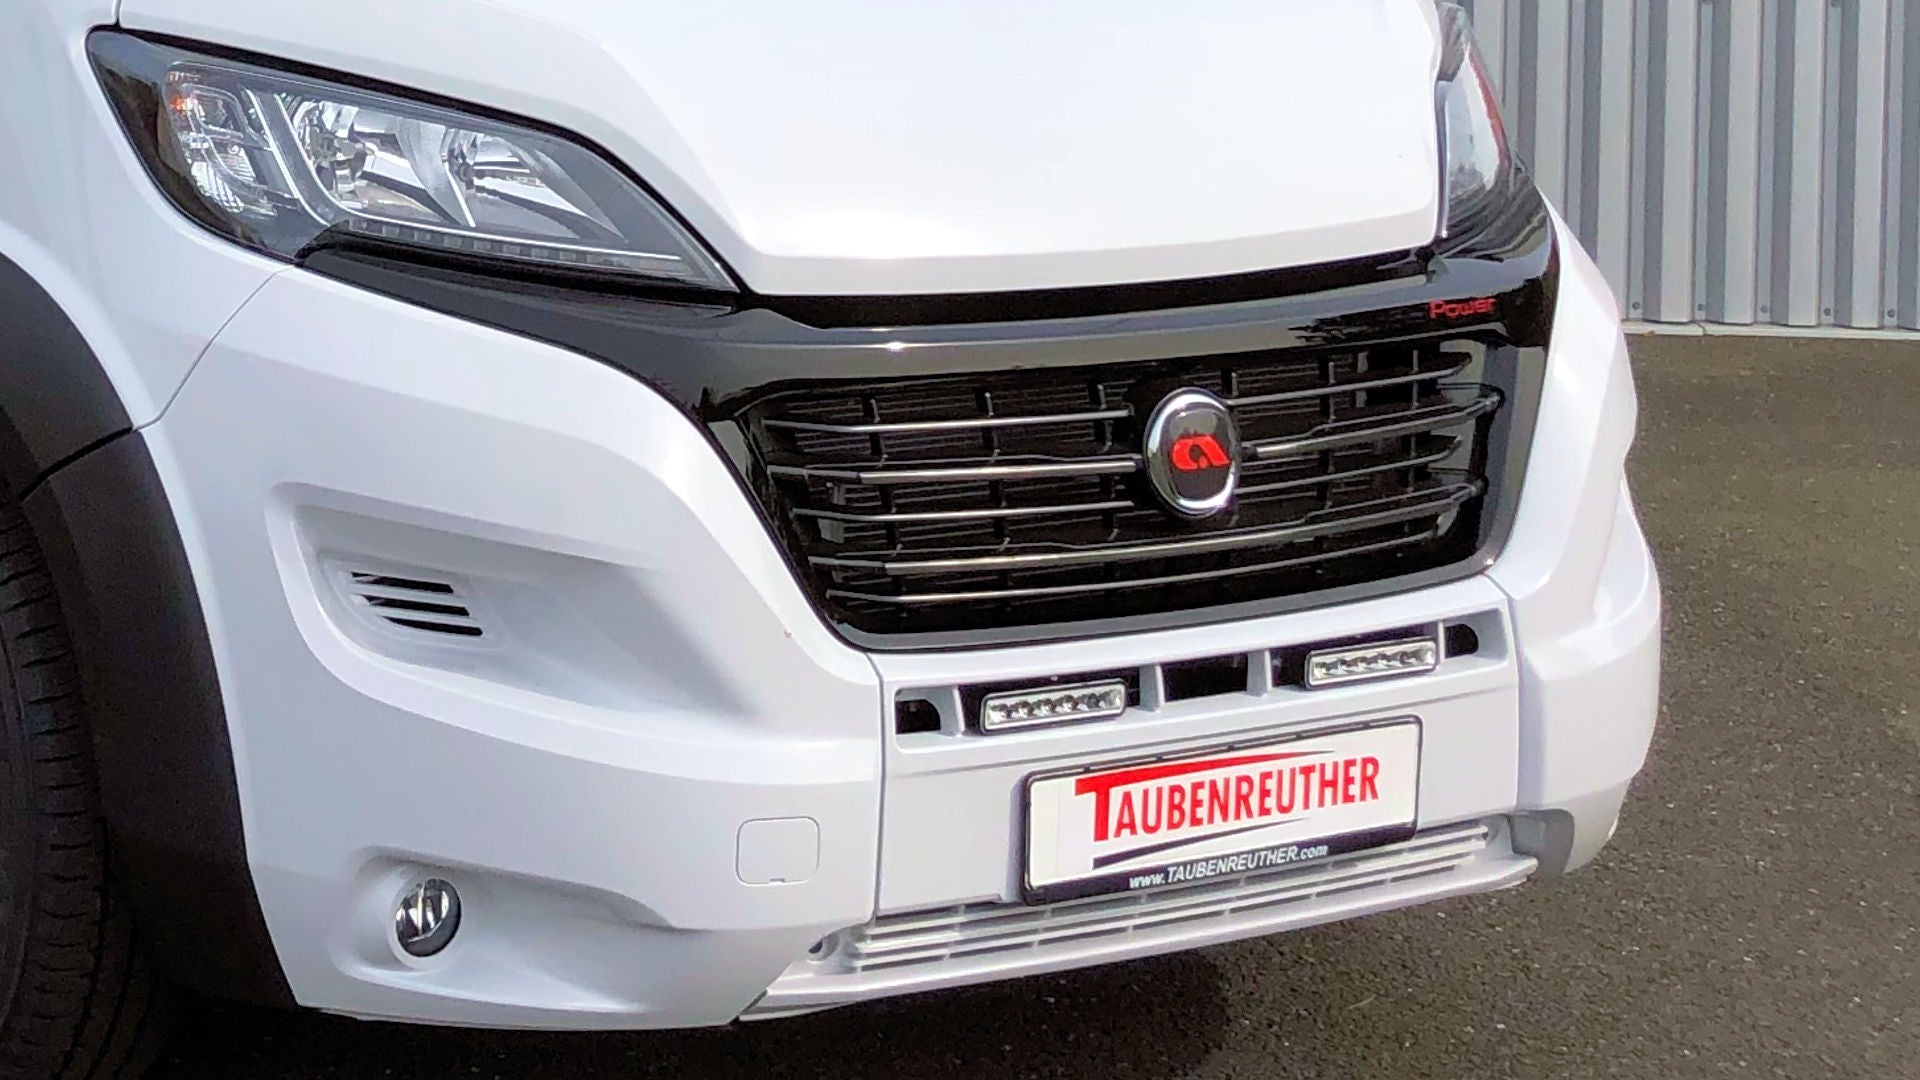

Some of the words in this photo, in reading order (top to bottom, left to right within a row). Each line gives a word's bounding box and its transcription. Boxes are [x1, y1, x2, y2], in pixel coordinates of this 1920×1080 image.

[1429, 298, 1496, 318] Power
[1074, 750, 1380, 843] TAUBENREUTHER
[1128, 845, 1329, 890] www.TAUBENREUTHER.com
